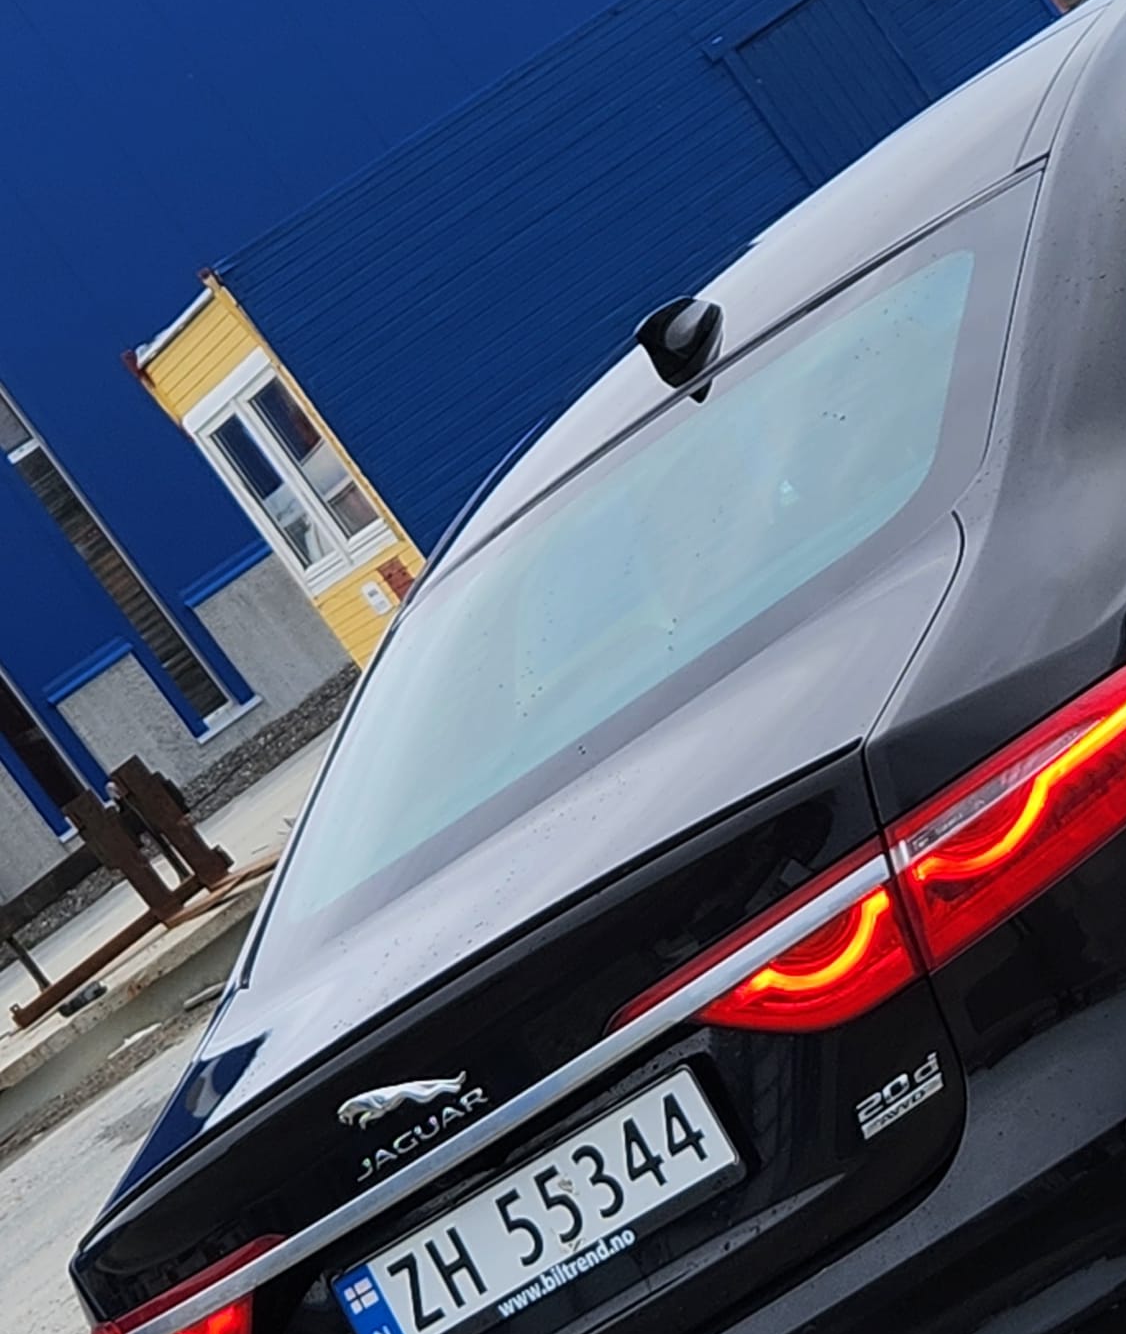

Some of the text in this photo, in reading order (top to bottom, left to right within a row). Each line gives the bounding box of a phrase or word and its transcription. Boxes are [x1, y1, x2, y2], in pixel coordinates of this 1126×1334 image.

[855, 1050, 940, 1124] 20d
[356, 1087, 488, 1183] JAGUAR
[386, 1092, 708, 1333] ZH 55344
[497, 1229, 636, 1318] www.biltrend.no
